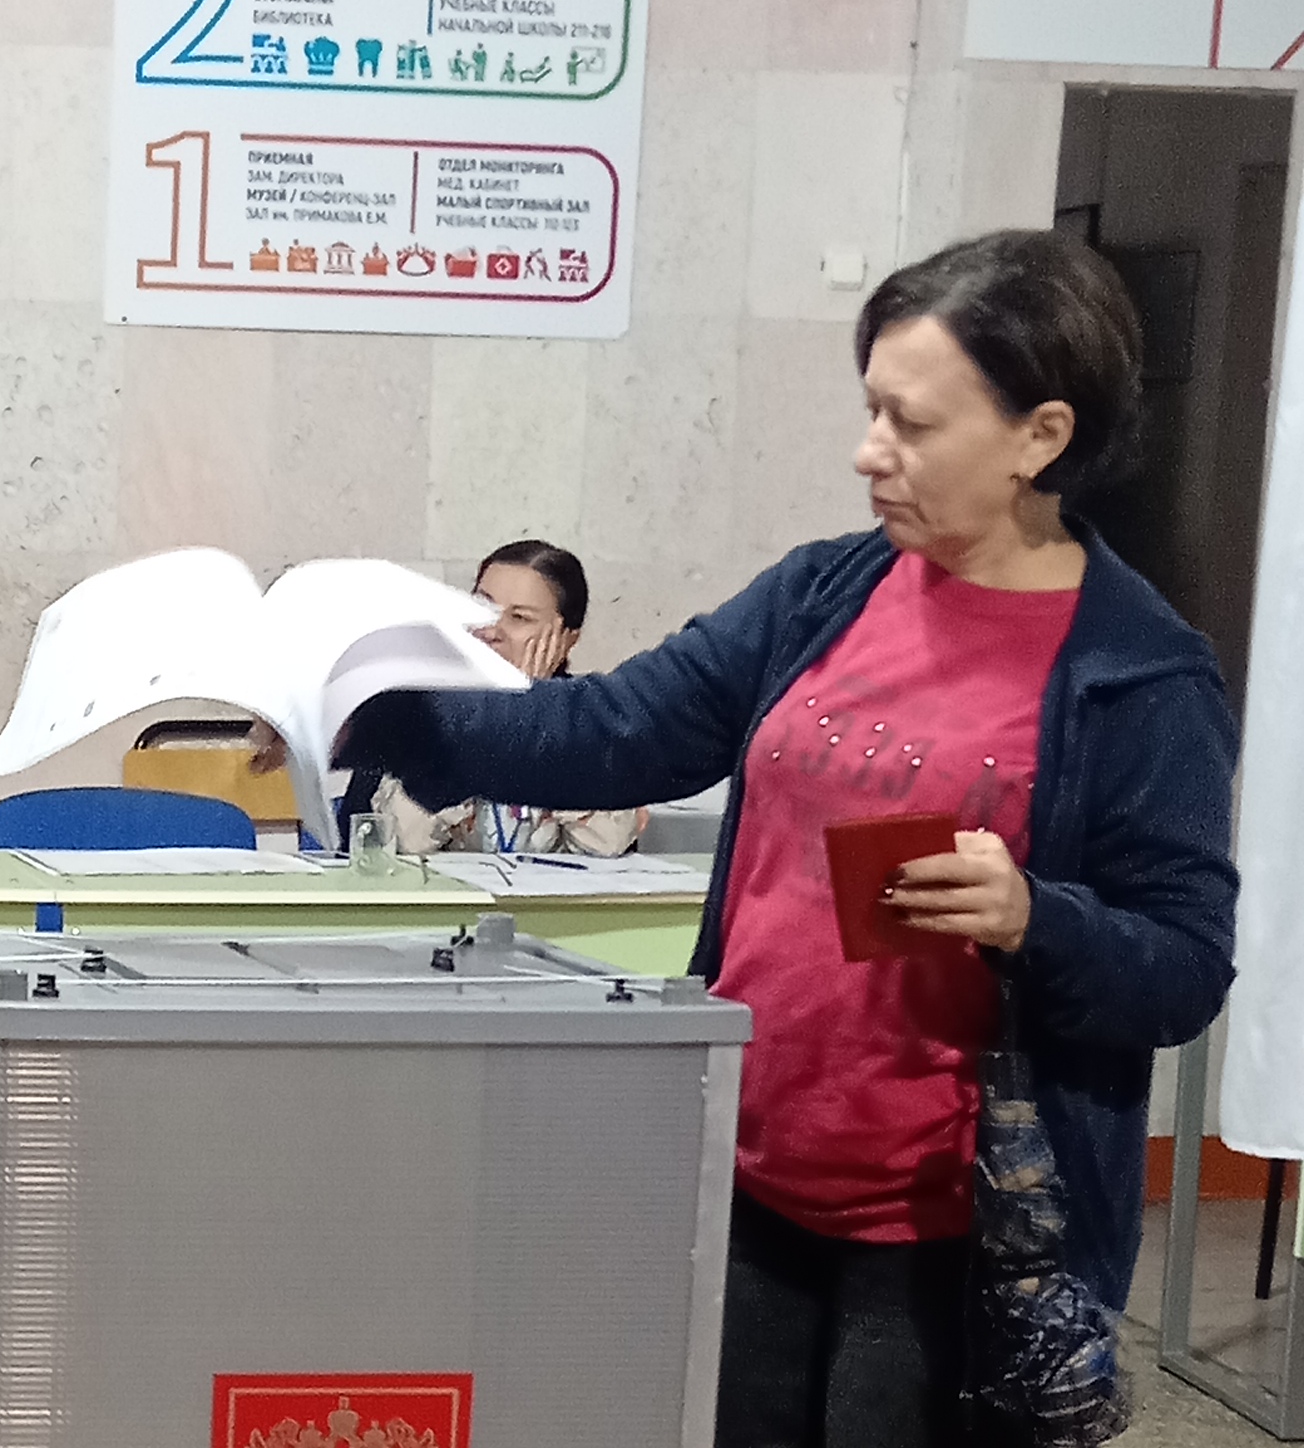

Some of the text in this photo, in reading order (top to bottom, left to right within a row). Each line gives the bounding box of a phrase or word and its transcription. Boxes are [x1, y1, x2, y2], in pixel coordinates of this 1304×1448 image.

[502, 0, 555, 16] КЛАССЫ
[253, 10, 333, 26] БИБЛИОТЕКА
[438, 18, 513, 34] НАЧАЛЬНОЙ
[248, 150, 313, 165] ПРИЕМНАЯ
[438, 157, 564, 175] ОТДЕЛ МОНИТОРИНГА
[278, 171, 344, 185] ДИРЕКТОРА
[469, 178, 519, 192] КАБИНЕТ
[246, 186, 286, 202] МУЗЕЙ
[136, 130, 235, 288] 1
[436, 194, 590, 213] МАЛЫЙ СПОРТИВНЫЙ ЗАЛ
[246, 207, 269, 220] ЗАЛ
[293, 208, 363, 223] ПРИМАКОВА
